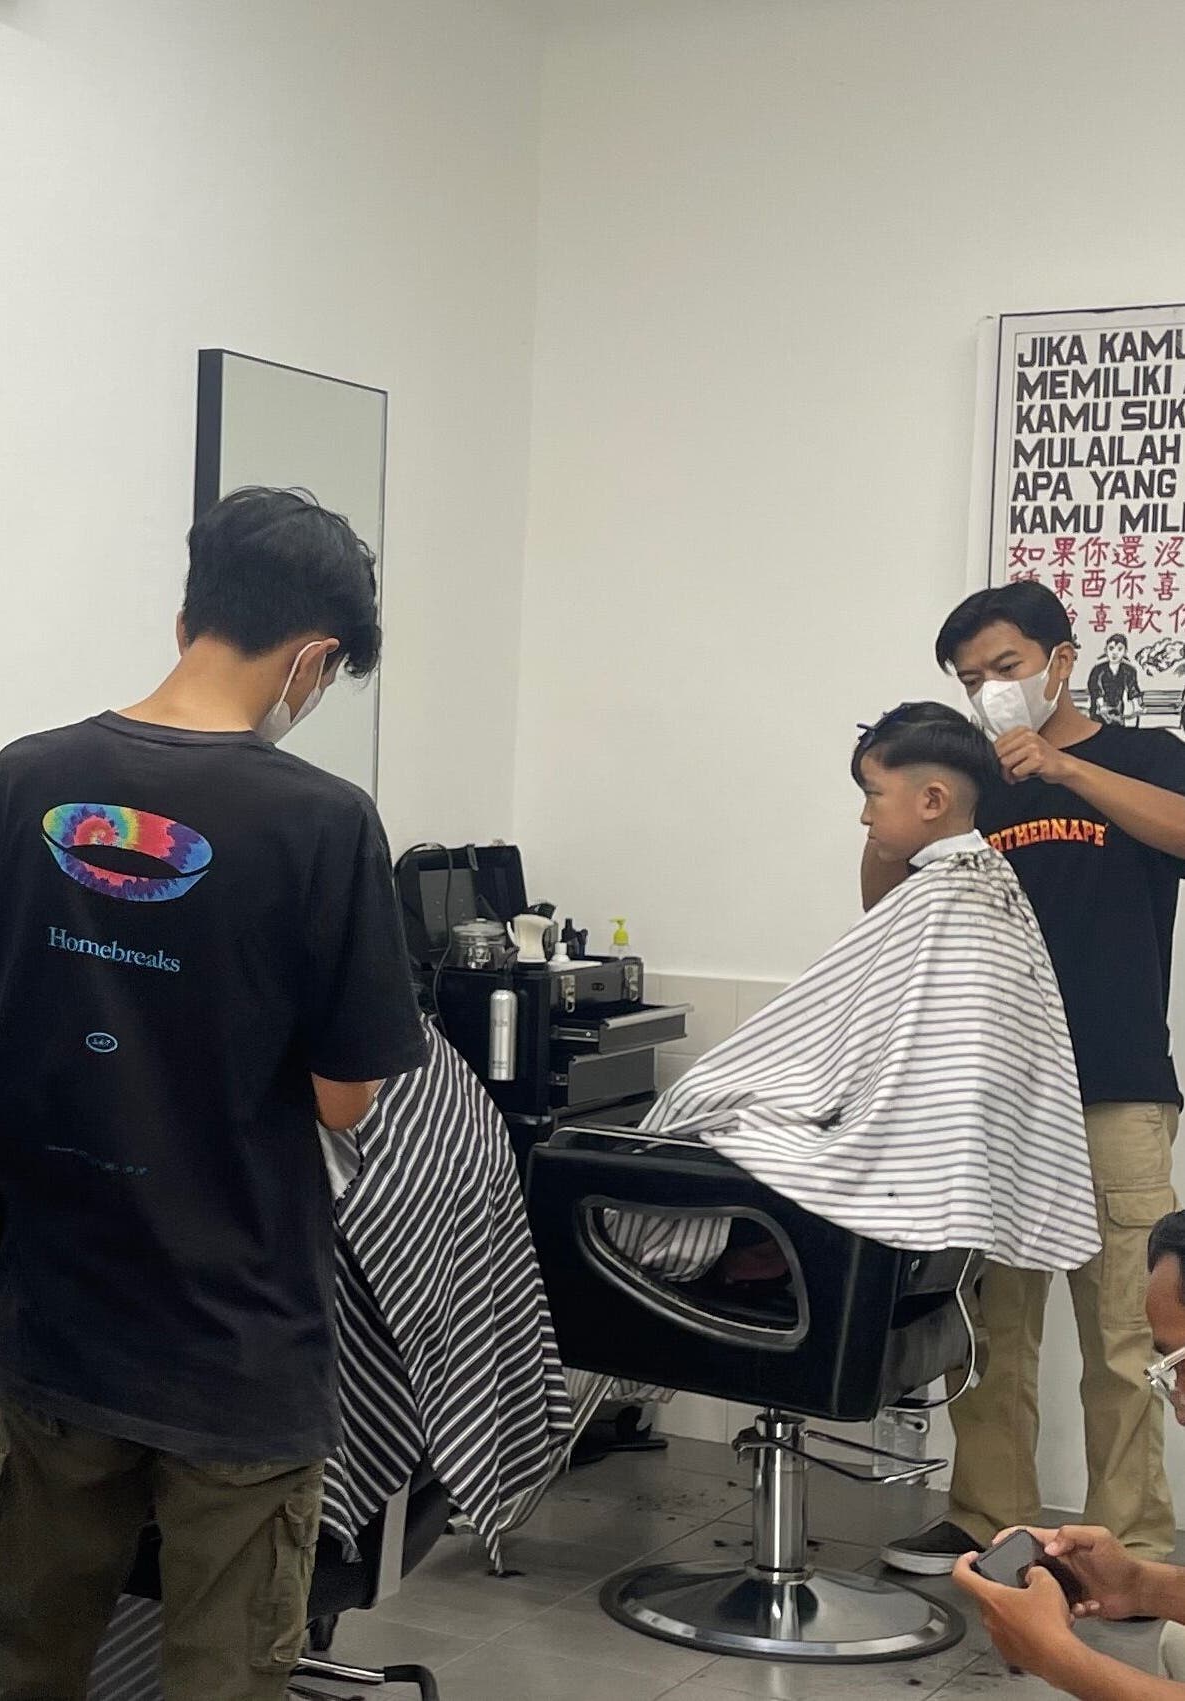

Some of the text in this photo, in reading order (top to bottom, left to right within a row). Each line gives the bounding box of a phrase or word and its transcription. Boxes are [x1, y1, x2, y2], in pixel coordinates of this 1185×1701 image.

[1017, 334, 1088, 368] JIKA
[1016, 364, 1173, 402] MEMILIKI
[1016, 401, 1112, 435] KAMU
[1013, 434, 1181, 469] MULAILAH
[1011, 468, 1177, 502] APA YANG
[1010, 503, 1104, 535] KAMU
[985, 818, 1106, 852] RTHERNAPE
[47, 926, 182, 973] Homebreaks
